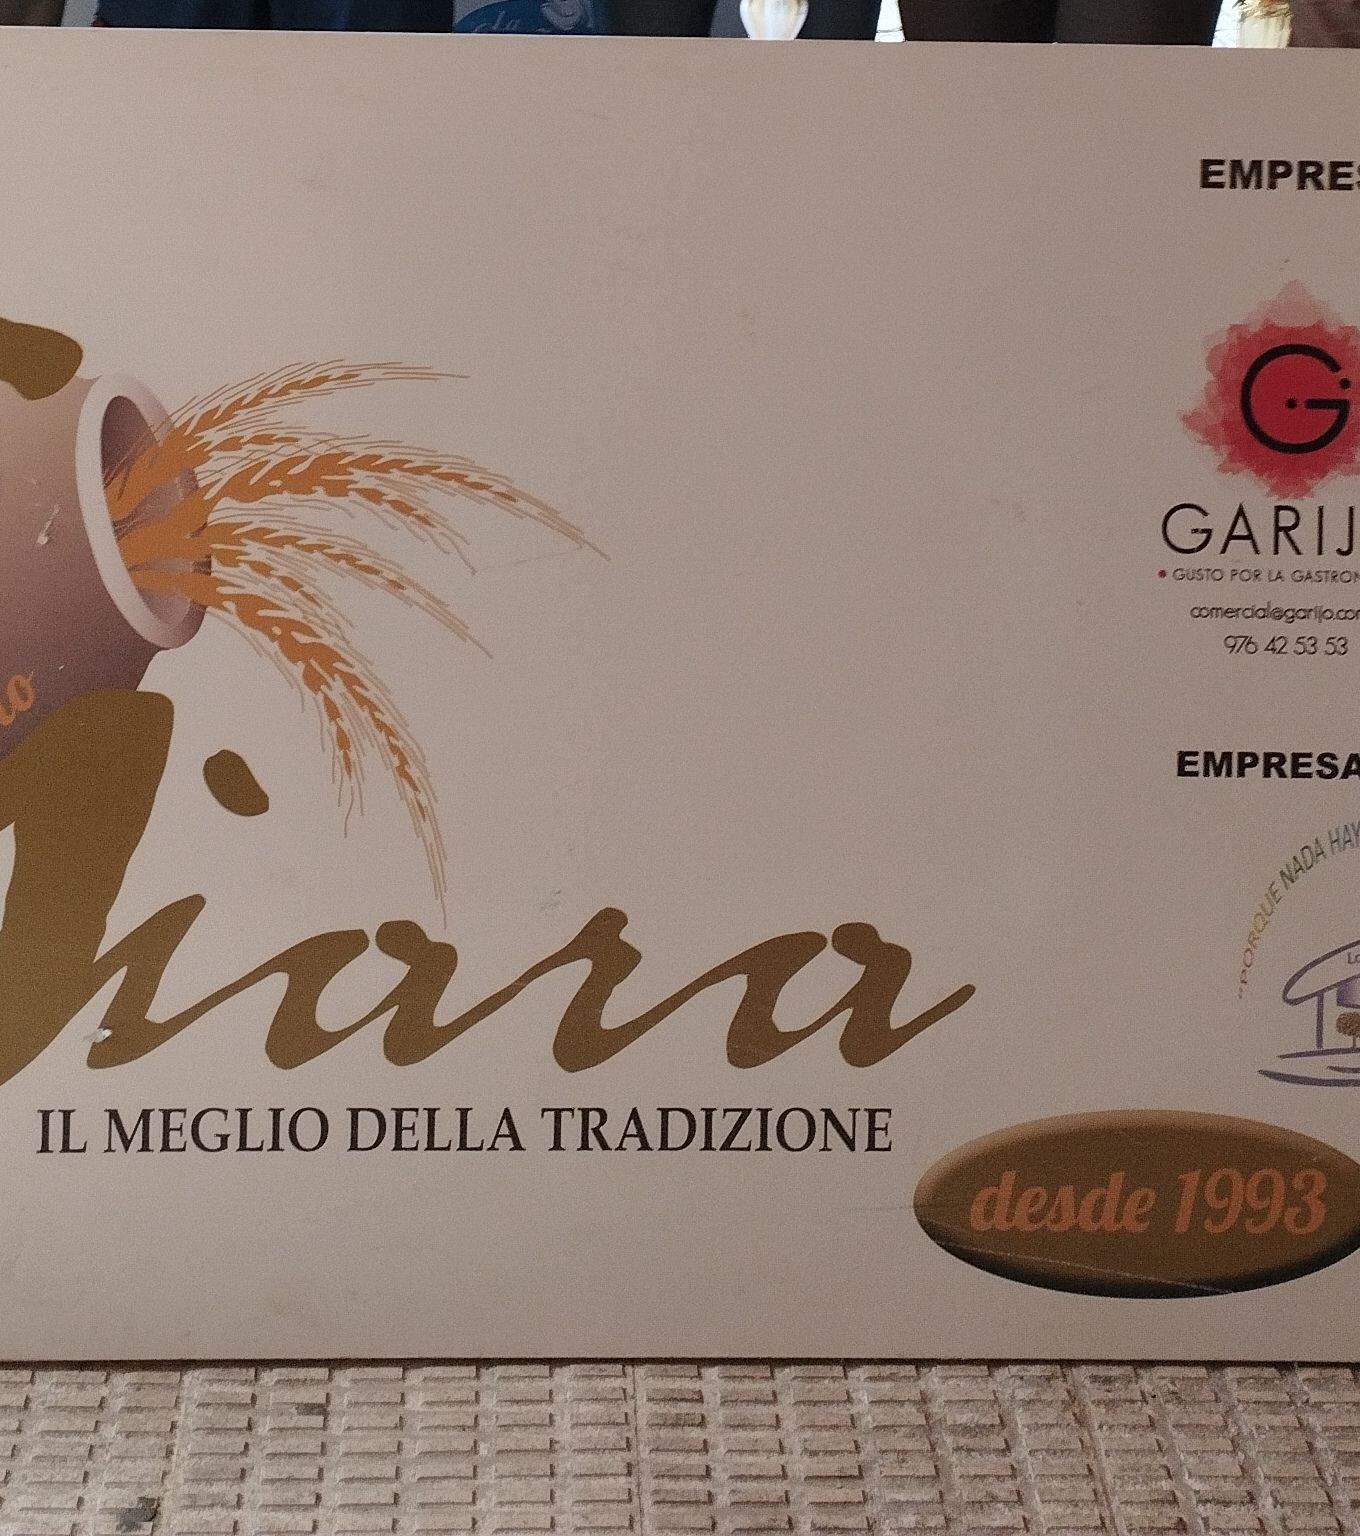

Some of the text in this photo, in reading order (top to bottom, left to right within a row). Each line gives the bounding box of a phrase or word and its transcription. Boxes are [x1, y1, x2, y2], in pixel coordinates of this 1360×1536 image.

[1171, 567, 1224, 583] GUSTO
[1230, 568, 1262, 583] POR
[1267, 569, 1285, 583] LA
[1222, 634, 1350, 656] 976 42 53 53
[1278, 837, 1329, 892] NADA
[35, 1106, 894, 1154] IL MEGLIO DELLA TRADIZIONE
[969, 1167, 1327, 1236] desde 1993
